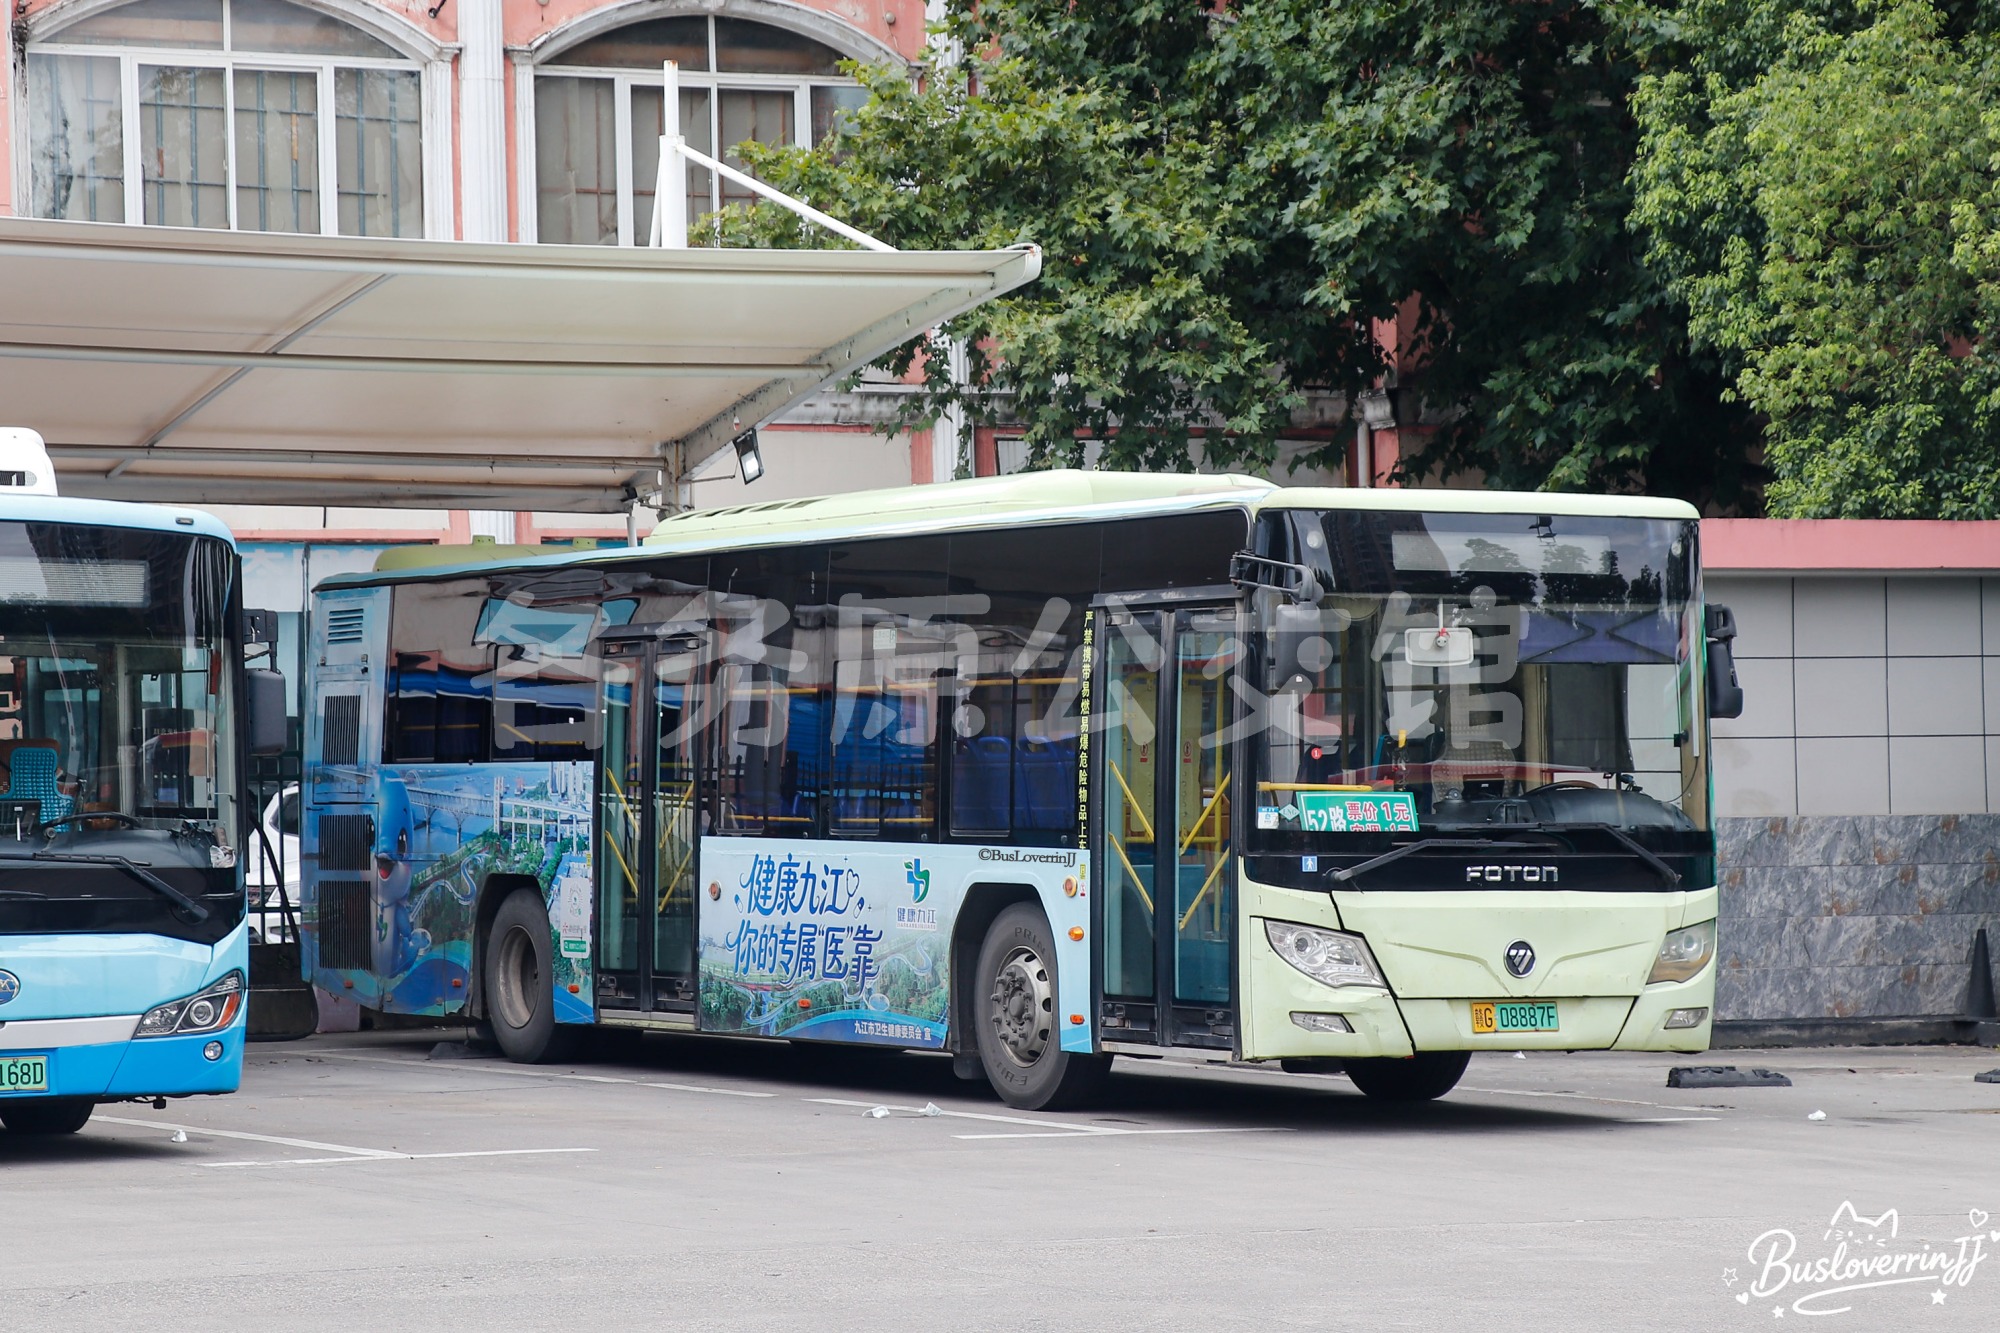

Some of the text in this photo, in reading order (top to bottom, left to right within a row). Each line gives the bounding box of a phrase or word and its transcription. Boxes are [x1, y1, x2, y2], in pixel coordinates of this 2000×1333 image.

[1078, 610, 1094, 850] 严禁携带易燃易爆危险物品上车
[1466, 865, 1559, 882] FOTON
[740, 853, 859, 916] 健康九江
[897, 907, 936, 924] 健康九江
[854, 1020, 922, 1040] 九江市卫生健康委员会
